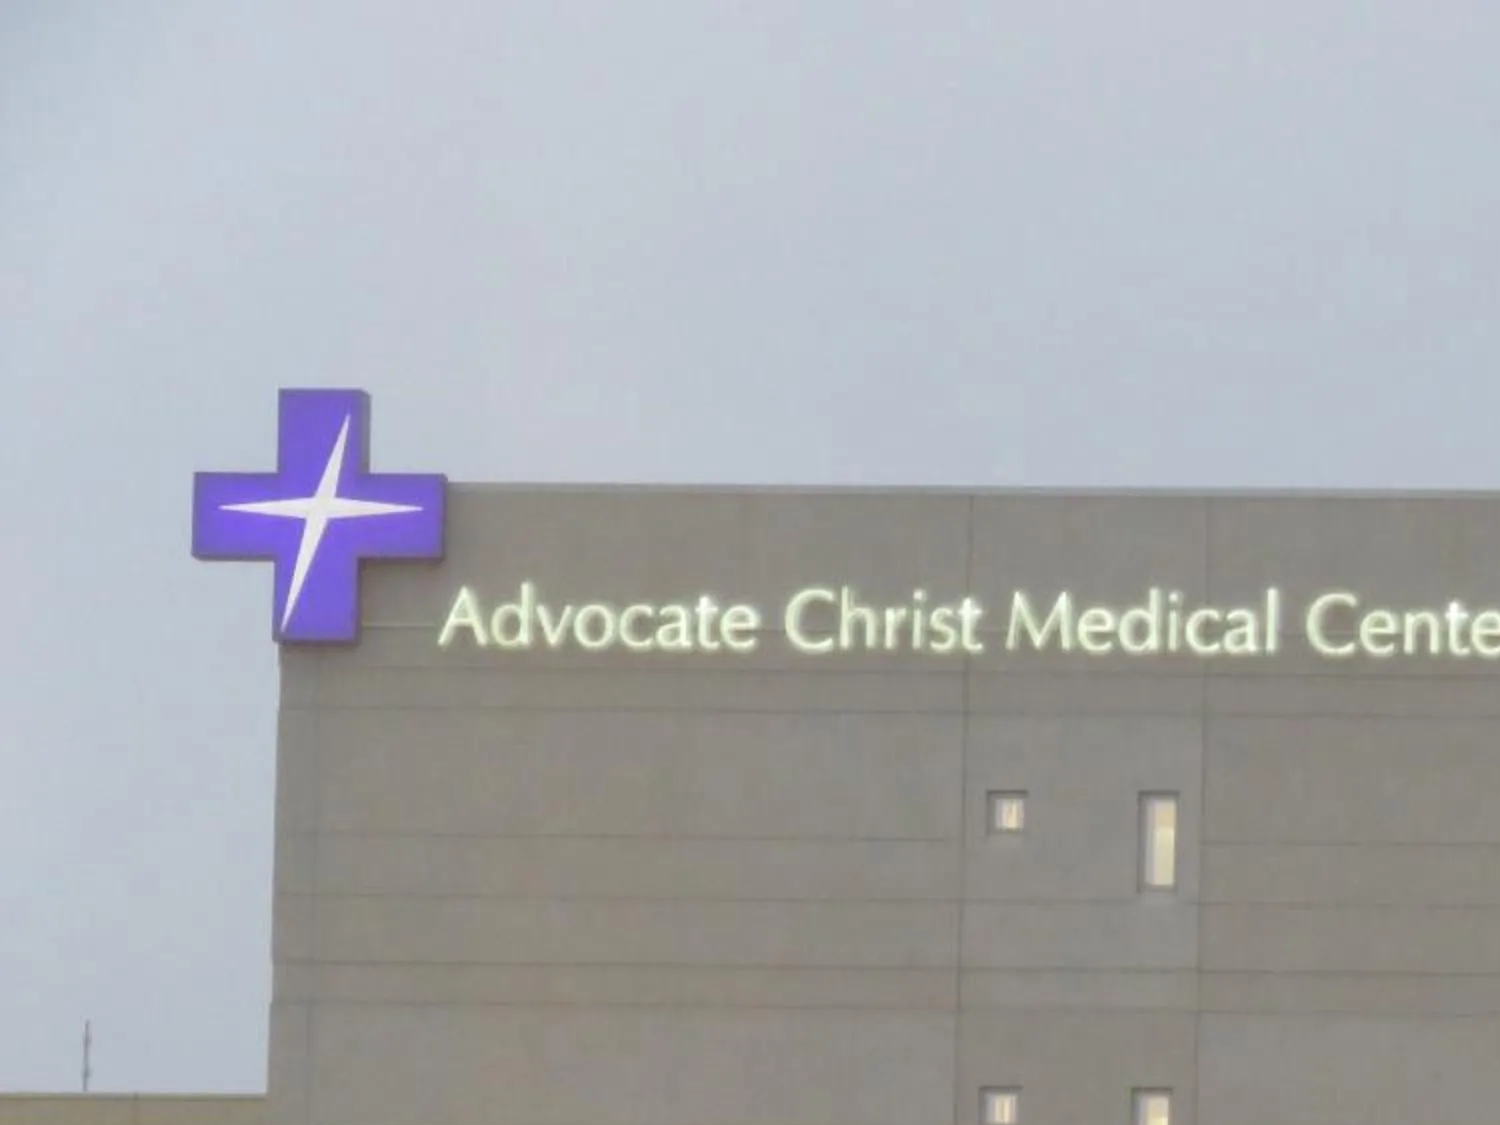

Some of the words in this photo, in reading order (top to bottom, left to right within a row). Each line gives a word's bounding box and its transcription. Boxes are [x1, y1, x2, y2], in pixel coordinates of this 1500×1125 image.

[437, 582, 761, 652] Advocate
[784, 585, 985, 653] Christ
[1004, 587, 1279, 655] Medical
